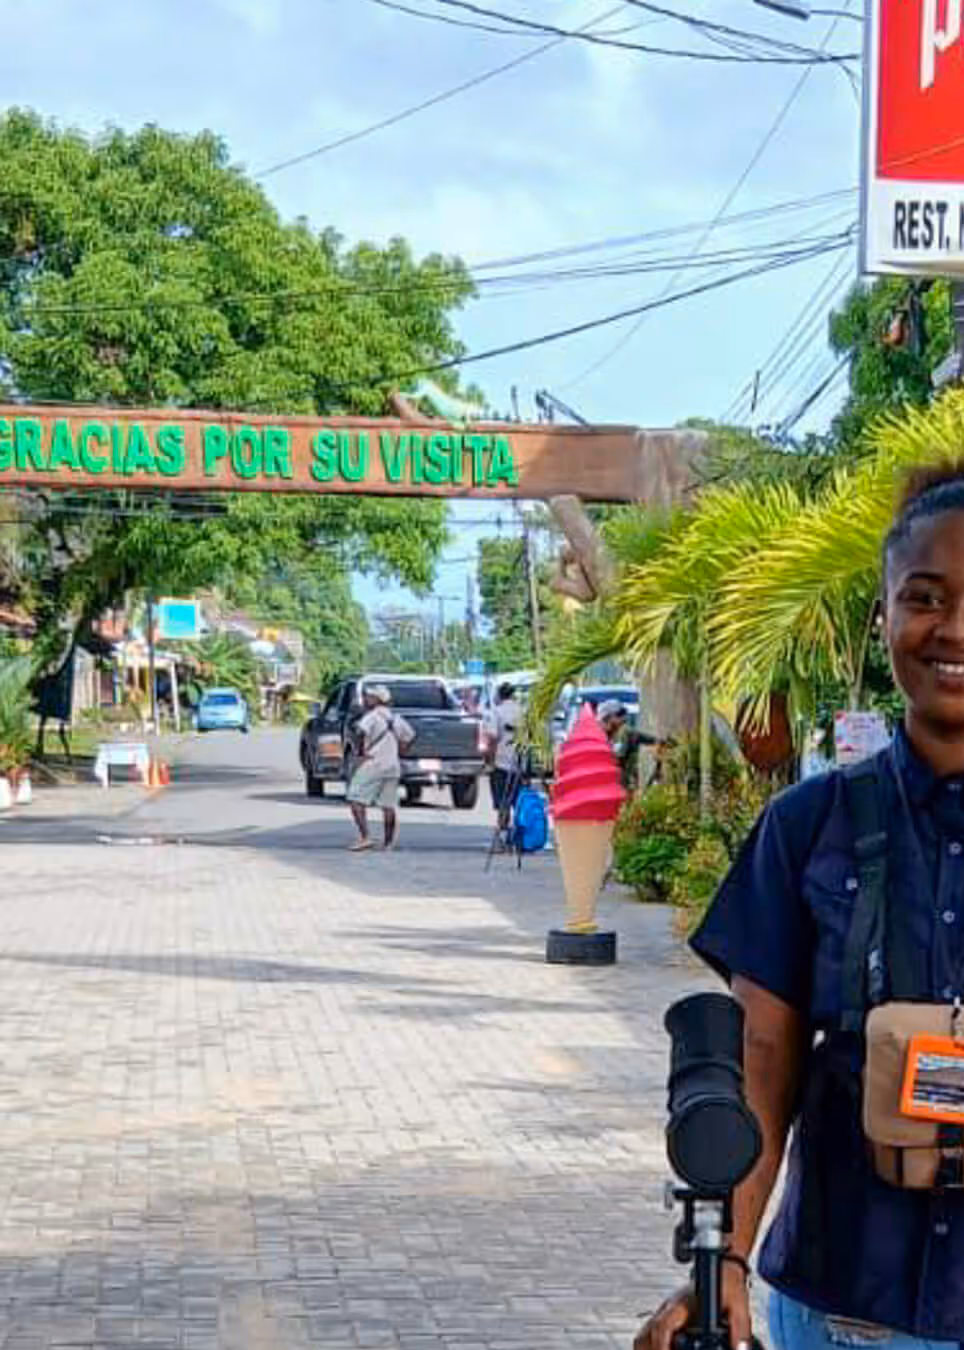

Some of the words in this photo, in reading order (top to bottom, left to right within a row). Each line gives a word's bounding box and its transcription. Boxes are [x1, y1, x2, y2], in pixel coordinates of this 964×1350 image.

[893, 201, 950, 250] REST.
[203, 423, 293, 478] POR
[311, 430, 370, 481] SU
[380, 431, 519, 487] VISITA
